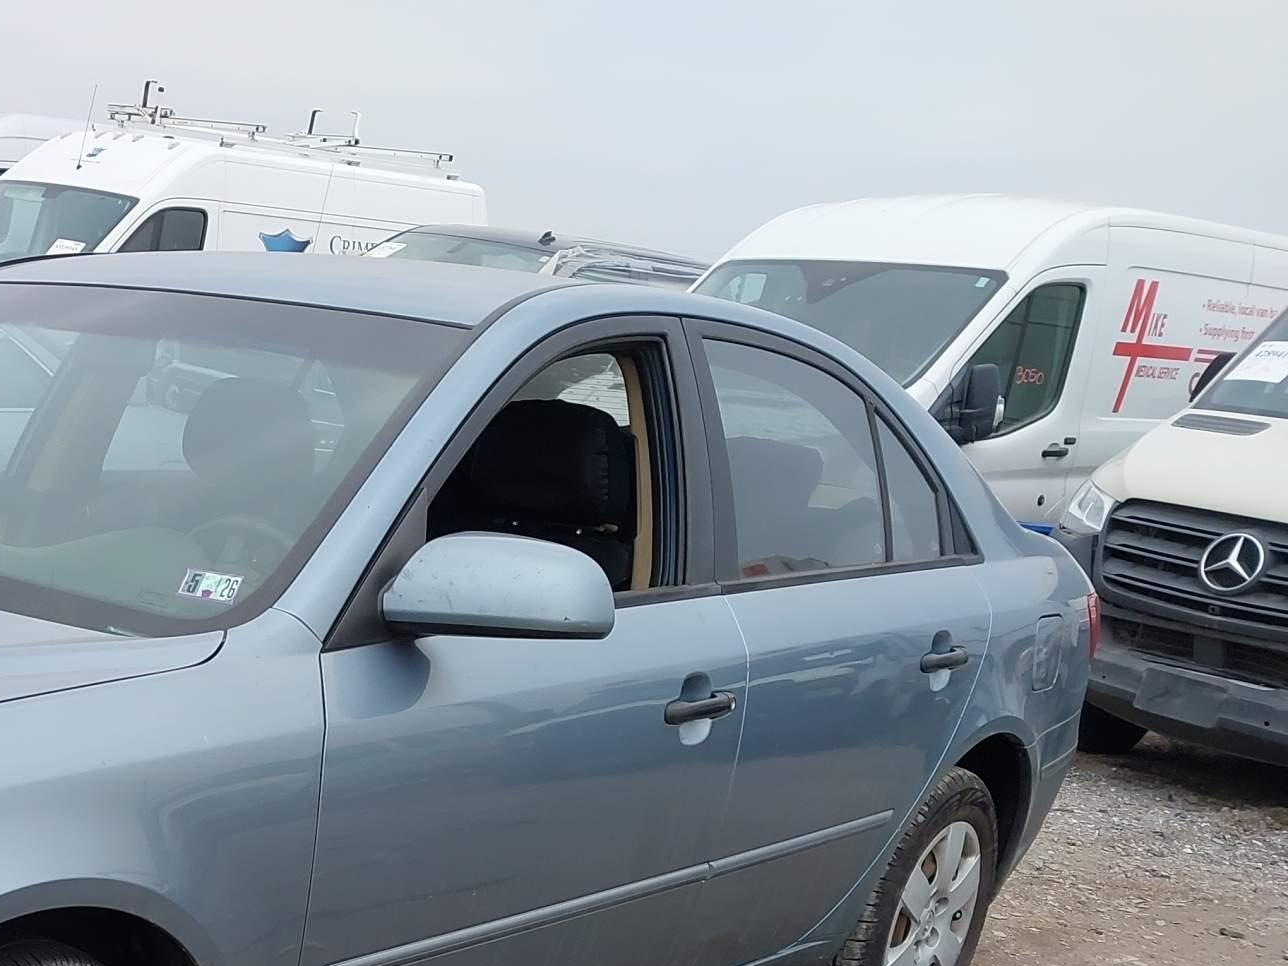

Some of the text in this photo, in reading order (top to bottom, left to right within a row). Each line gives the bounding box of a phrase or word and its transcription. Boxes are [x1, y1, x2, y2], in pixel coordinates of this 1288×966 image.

[1119, 278, 1169, 338] MIKE
[1203, 323, 1239, 342] Supplying
[186, 573, 239, 599] 5 26
